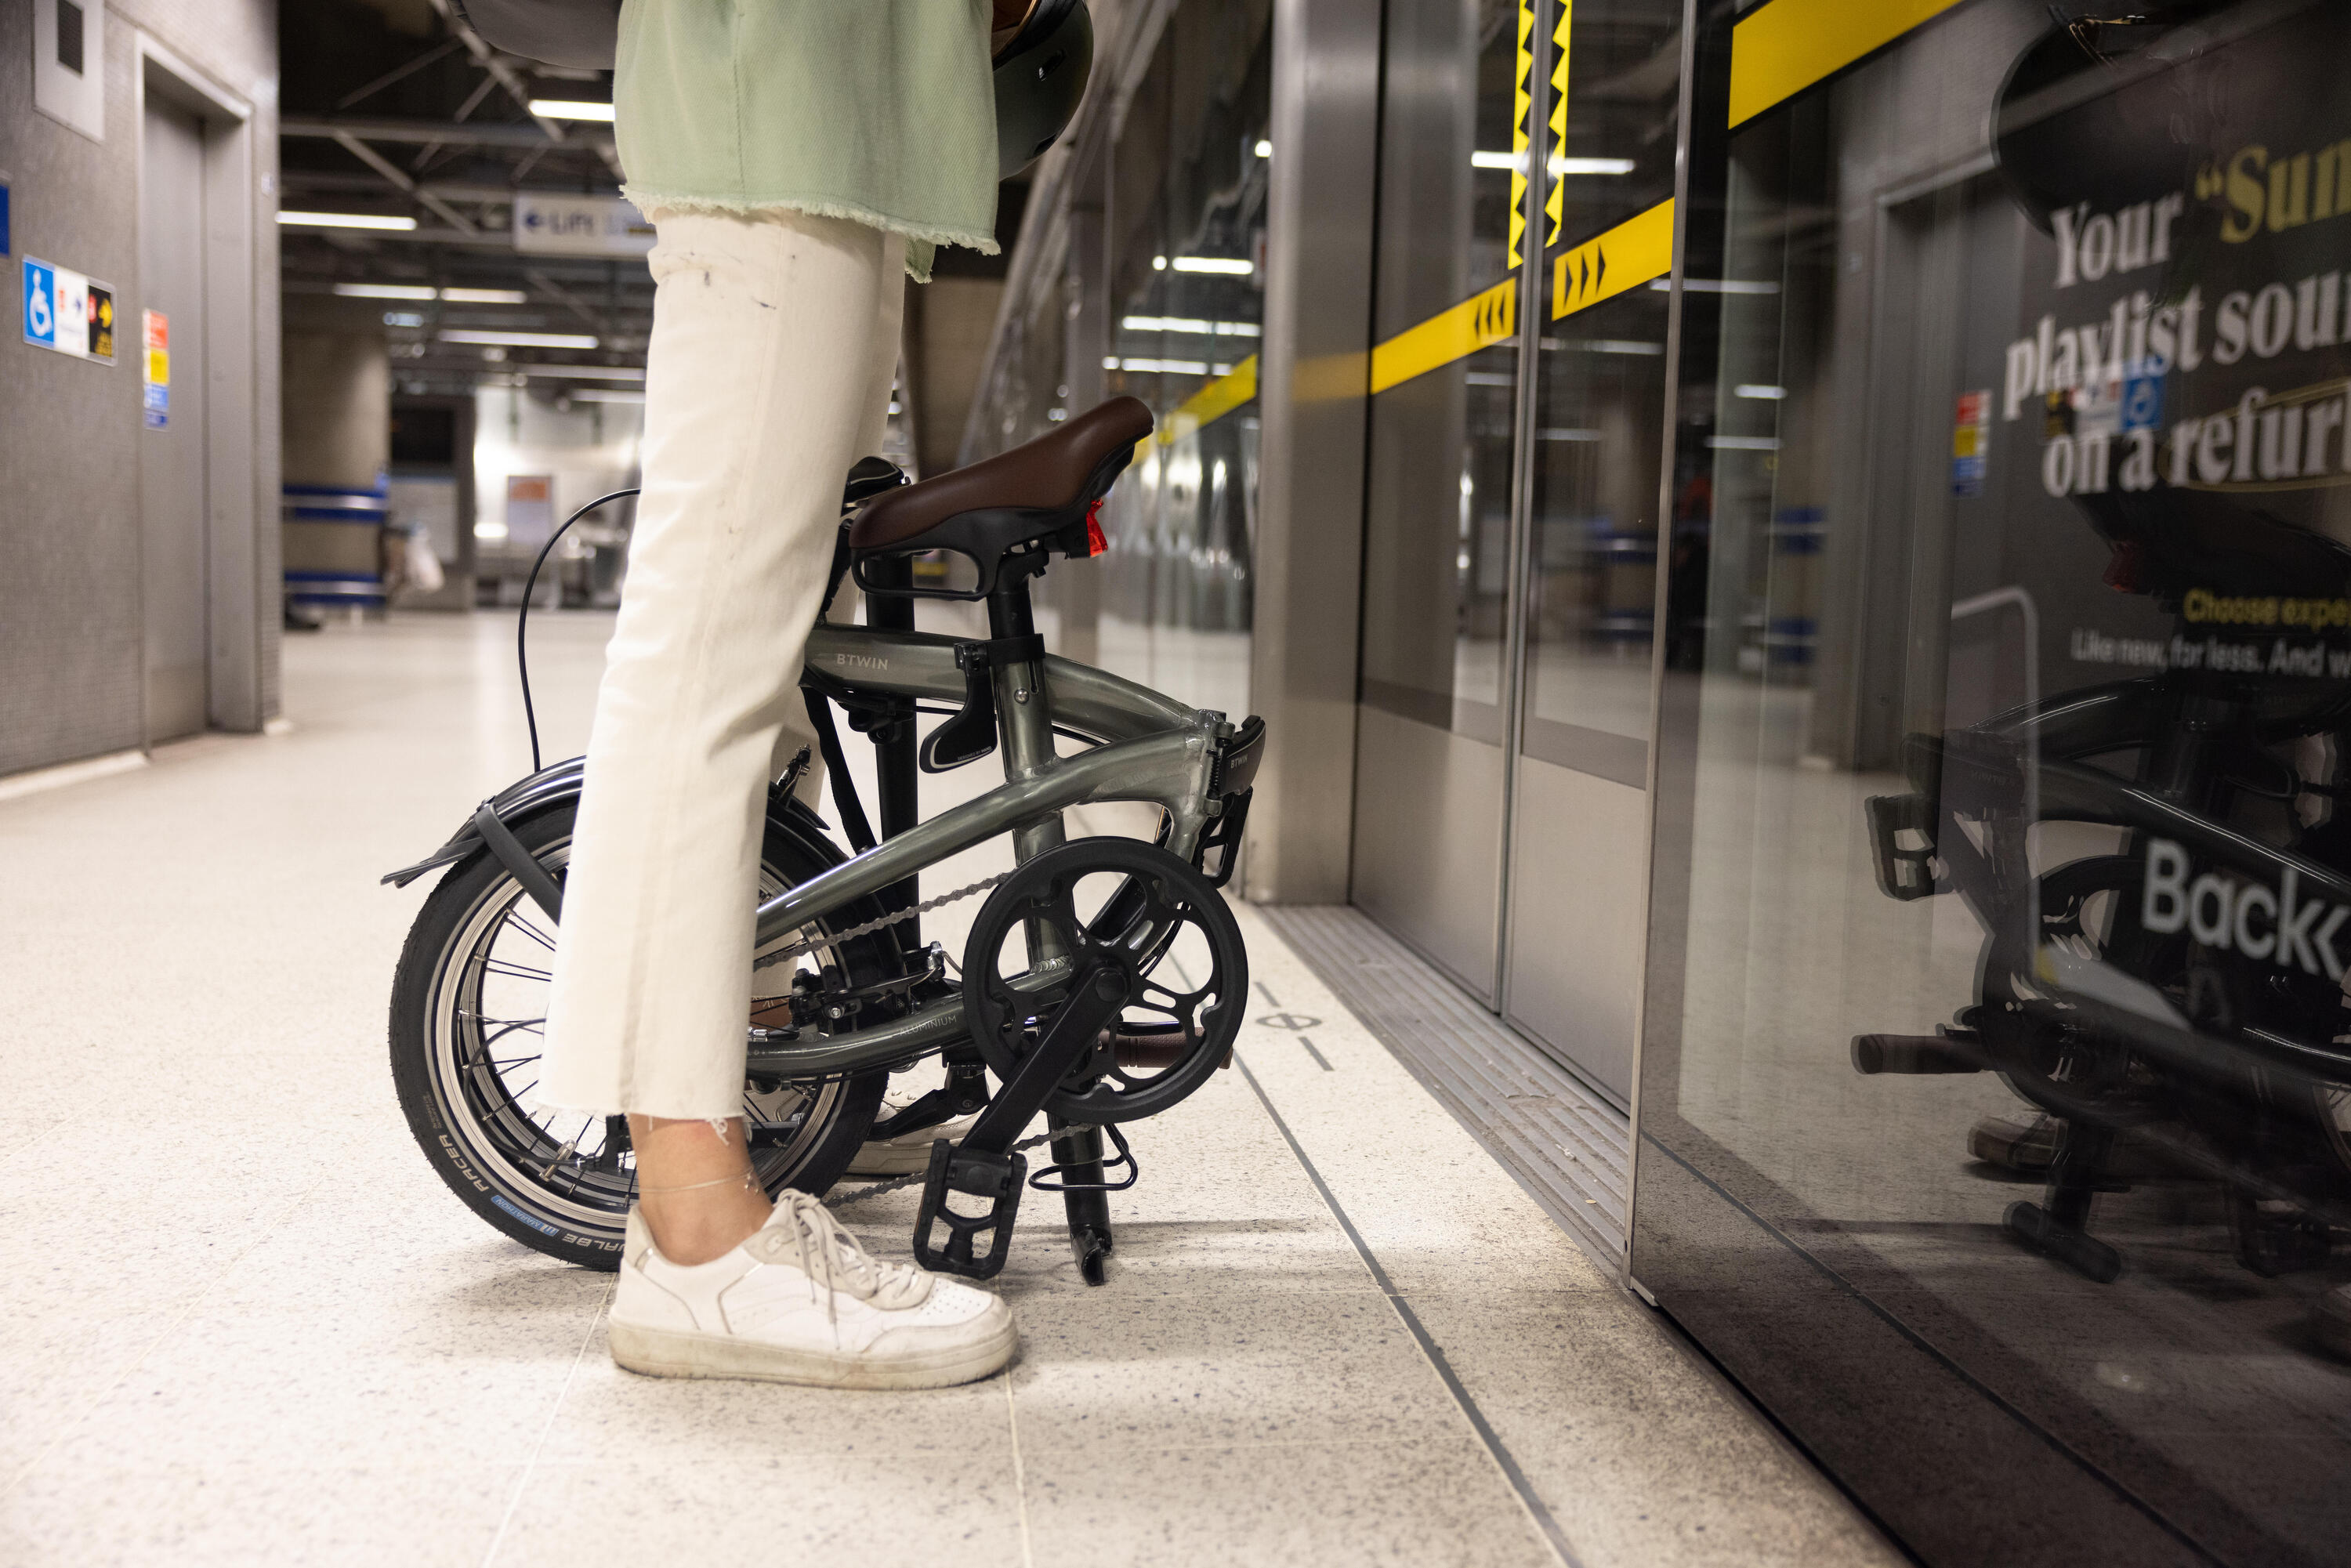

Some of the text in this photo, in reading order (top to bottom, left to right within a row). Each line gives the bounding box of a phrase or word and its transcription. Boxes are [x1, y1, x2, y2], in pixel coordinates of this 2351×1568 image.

[2050, 192, 2183, 288] Your
[2002, 284, 2203, 421] playlist
[2042, 430, 2110, 497] on
[2118, 428, 2157, 491] a
[2183, 588, 2351, 633] Choose expe
[837, 654, 889, 671] BTWIN
[2070, 628, 2114, 663] Like
[2169, 633, 2204, 668] for
[2204, 635, 2265, 672] less.
[2267, 638, 2325, 677] And
[1230, 754, 1248, 769] BTWIN
[2142, 835, 2325, 976] Back
[900, 1015, 957, 1036] ALUMINIUM
[439, 1134, 490, 1192] RACER
[495, 1198, 541, 1229] MARATHON
